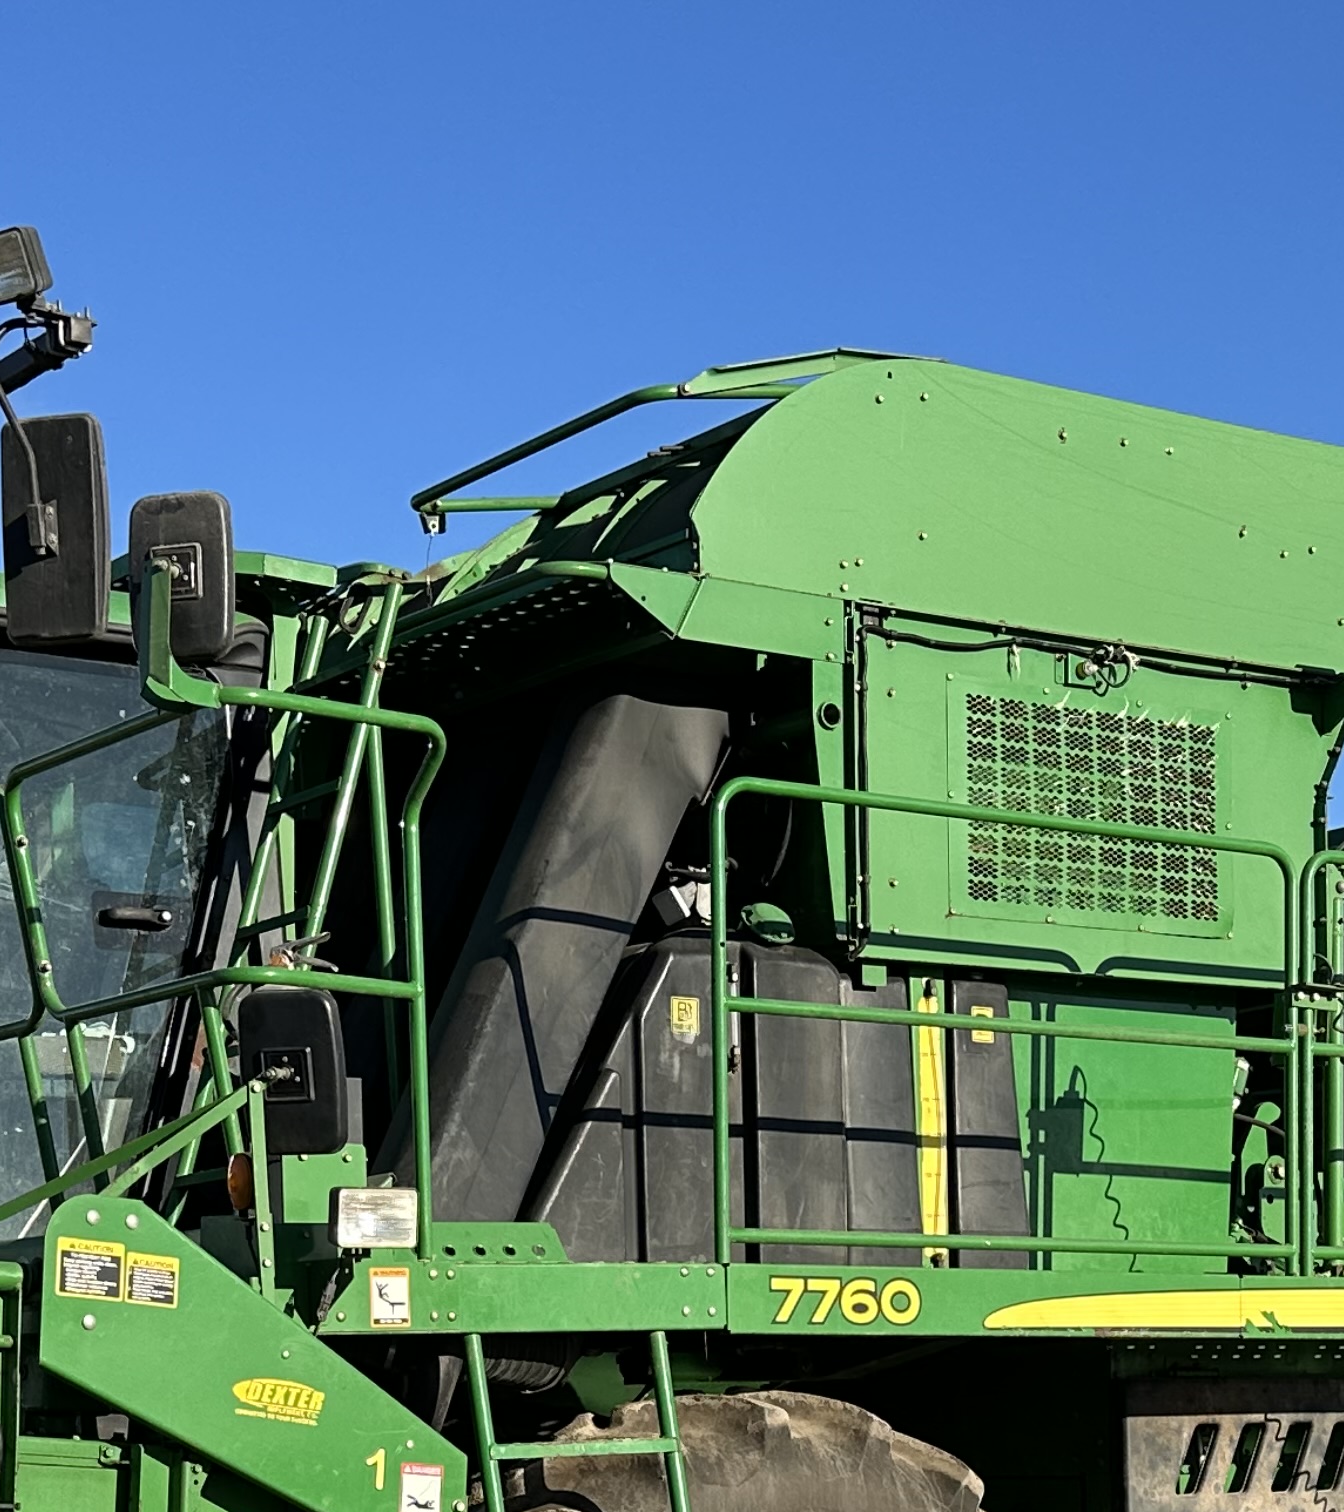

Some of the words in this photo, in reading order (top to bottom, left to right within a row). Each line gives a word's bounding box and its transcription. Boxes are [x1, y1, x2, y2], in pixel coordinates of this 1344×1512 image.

[77, 1243, 114, 1253] CAUTION
[139, 1260, 174, 1269] CAUTION
[769, 1275, 922, 1326] 7760
[246, 1382, 325, 1411] DEXTER
[365, 1448, 385, 1490] 1
